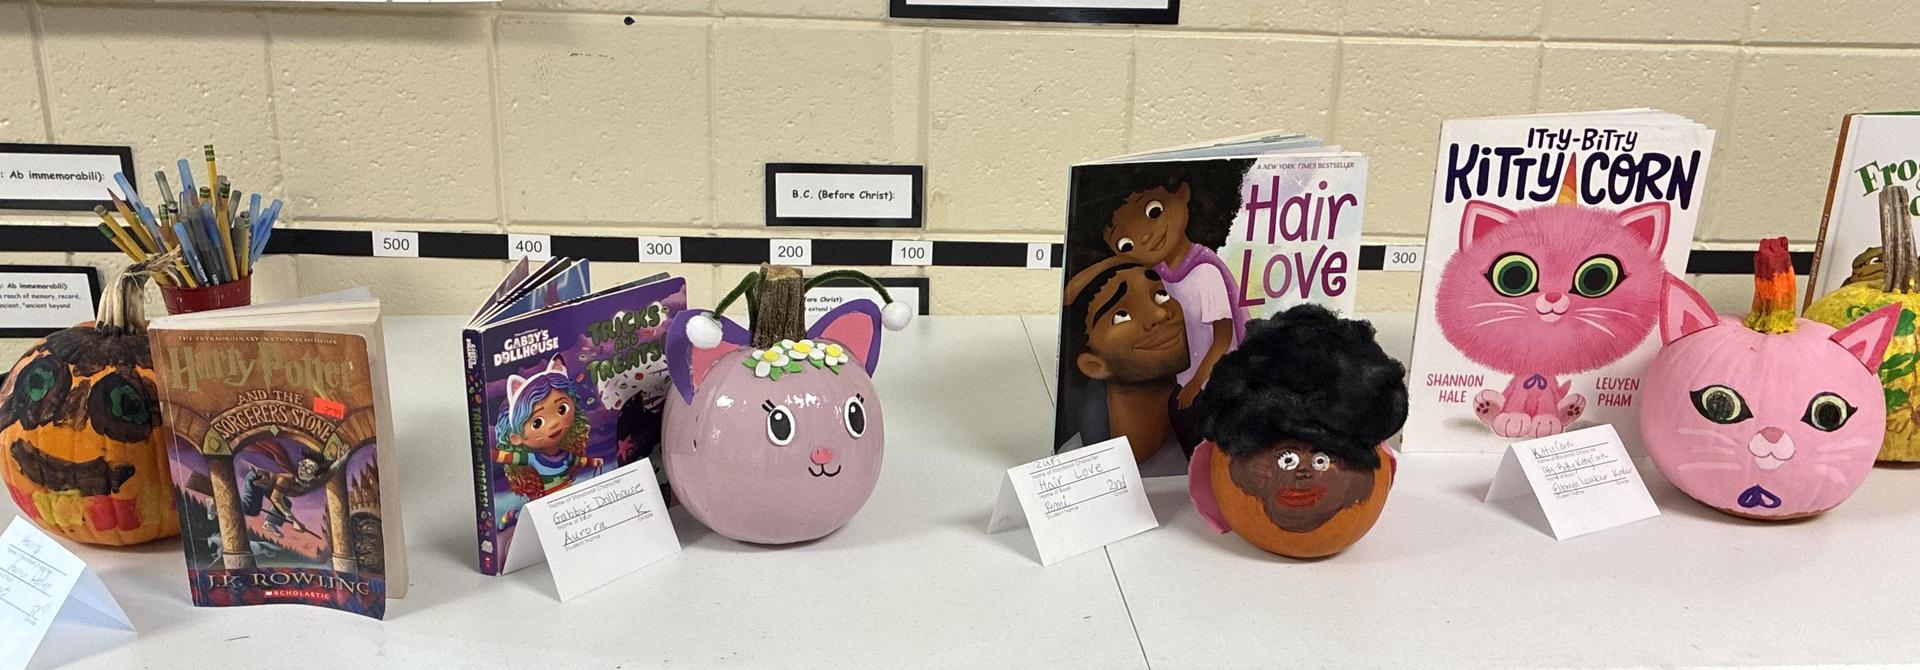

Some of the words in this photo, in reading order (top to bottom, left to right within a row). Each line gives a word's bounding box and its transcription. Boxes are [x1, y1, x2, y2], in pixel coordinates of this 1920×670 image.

[1317, 161, 1355, 169] BESTSELLER
[9, 170, 24, 180] Ab
[29, 170, 105, 182] immemorabili):
[1580, 149, 1701, 210] CORN
[792, 189, 813, 200] B.C.
[818, 189, 855, 200] (Before
[859, 189, 895, 201] Christ):
[1245, 175, 1357, 244] Hair
[383, 238, 410, 251] 500
[515, 240, 543, 253] 400
[646, 242, 673, 255] 300
[777, 245, 804, 258] 200
[900, 247, 925, 259] 100
[1036, 249, 1044, 260] 0
[1392, 252, 1417, 264] 300
[587, 304, 661, 346] TRICKS
[504, 329, 550, 351] GABBY'S
[615, 334, 638, 349] AND
[493, 336, 559, 367] DOLLHOUSE
[168, 346, 256, 391] Harry
[258, 342, 354, 398] Potter
[1426, 373, 1484, 388] SHANNON
[1595, 377, 1640, 391] LEUYEN
[238, 389, 267, 405] AND
[273, 390, 304, 406] THE
[1438, 390, 1467, 403] HALE
[1597, 394, 1632, 407] PHAM
[214, 404, 288, 439] SORCERER'S
[292, 409, 334, 442] STONE
[1039, 475, 1063, 491] Hair
[1073, 463, 1104, 479] Love
[552, 501, 591, 525] Gabby's
[563, 521, 608, 546] Aurora
[634, 503, 651, 514] K
[206, 574, 242, 591] J.K.
[252, 572, 369, 595] ROWLING
[274, 590, 329, 599] SCHOLASTIC
